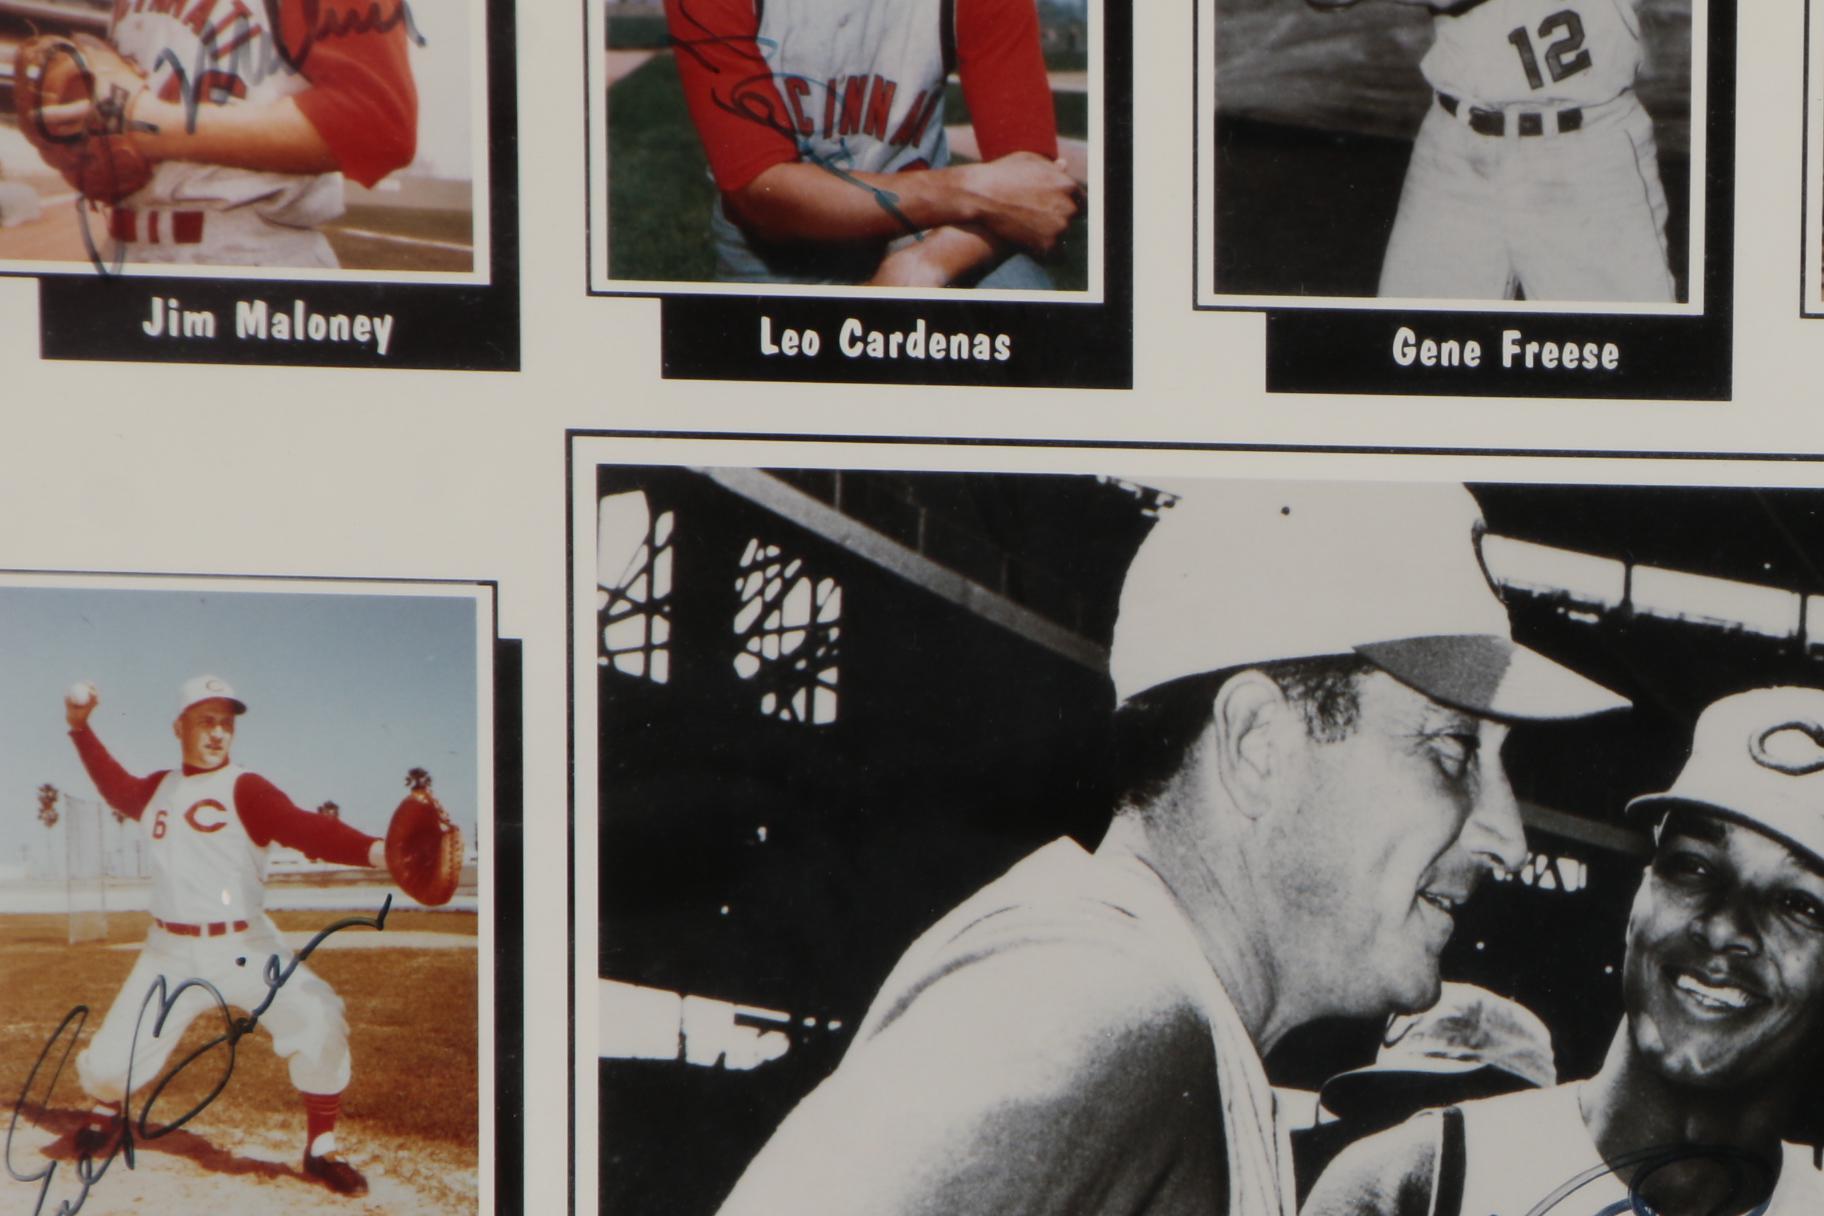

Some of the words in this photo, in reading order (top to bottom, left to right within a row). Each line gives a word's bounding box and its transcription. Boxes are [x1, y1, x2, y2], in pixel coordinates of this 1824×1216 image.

[1508, 5, 1594, 91] 12
[143, 297, 215, 338] Jim
[236, 299, 393, 355] Maloney
[761, 316, 820, 357] Leo
[839, 317, 1011, 361] Cardenas
[1392, 327, 1481, 368] Gene
[1502, 329, 1620, 370] Freese
[152, 809, 168, 840] 6
[183, 798, 228, 833] C
